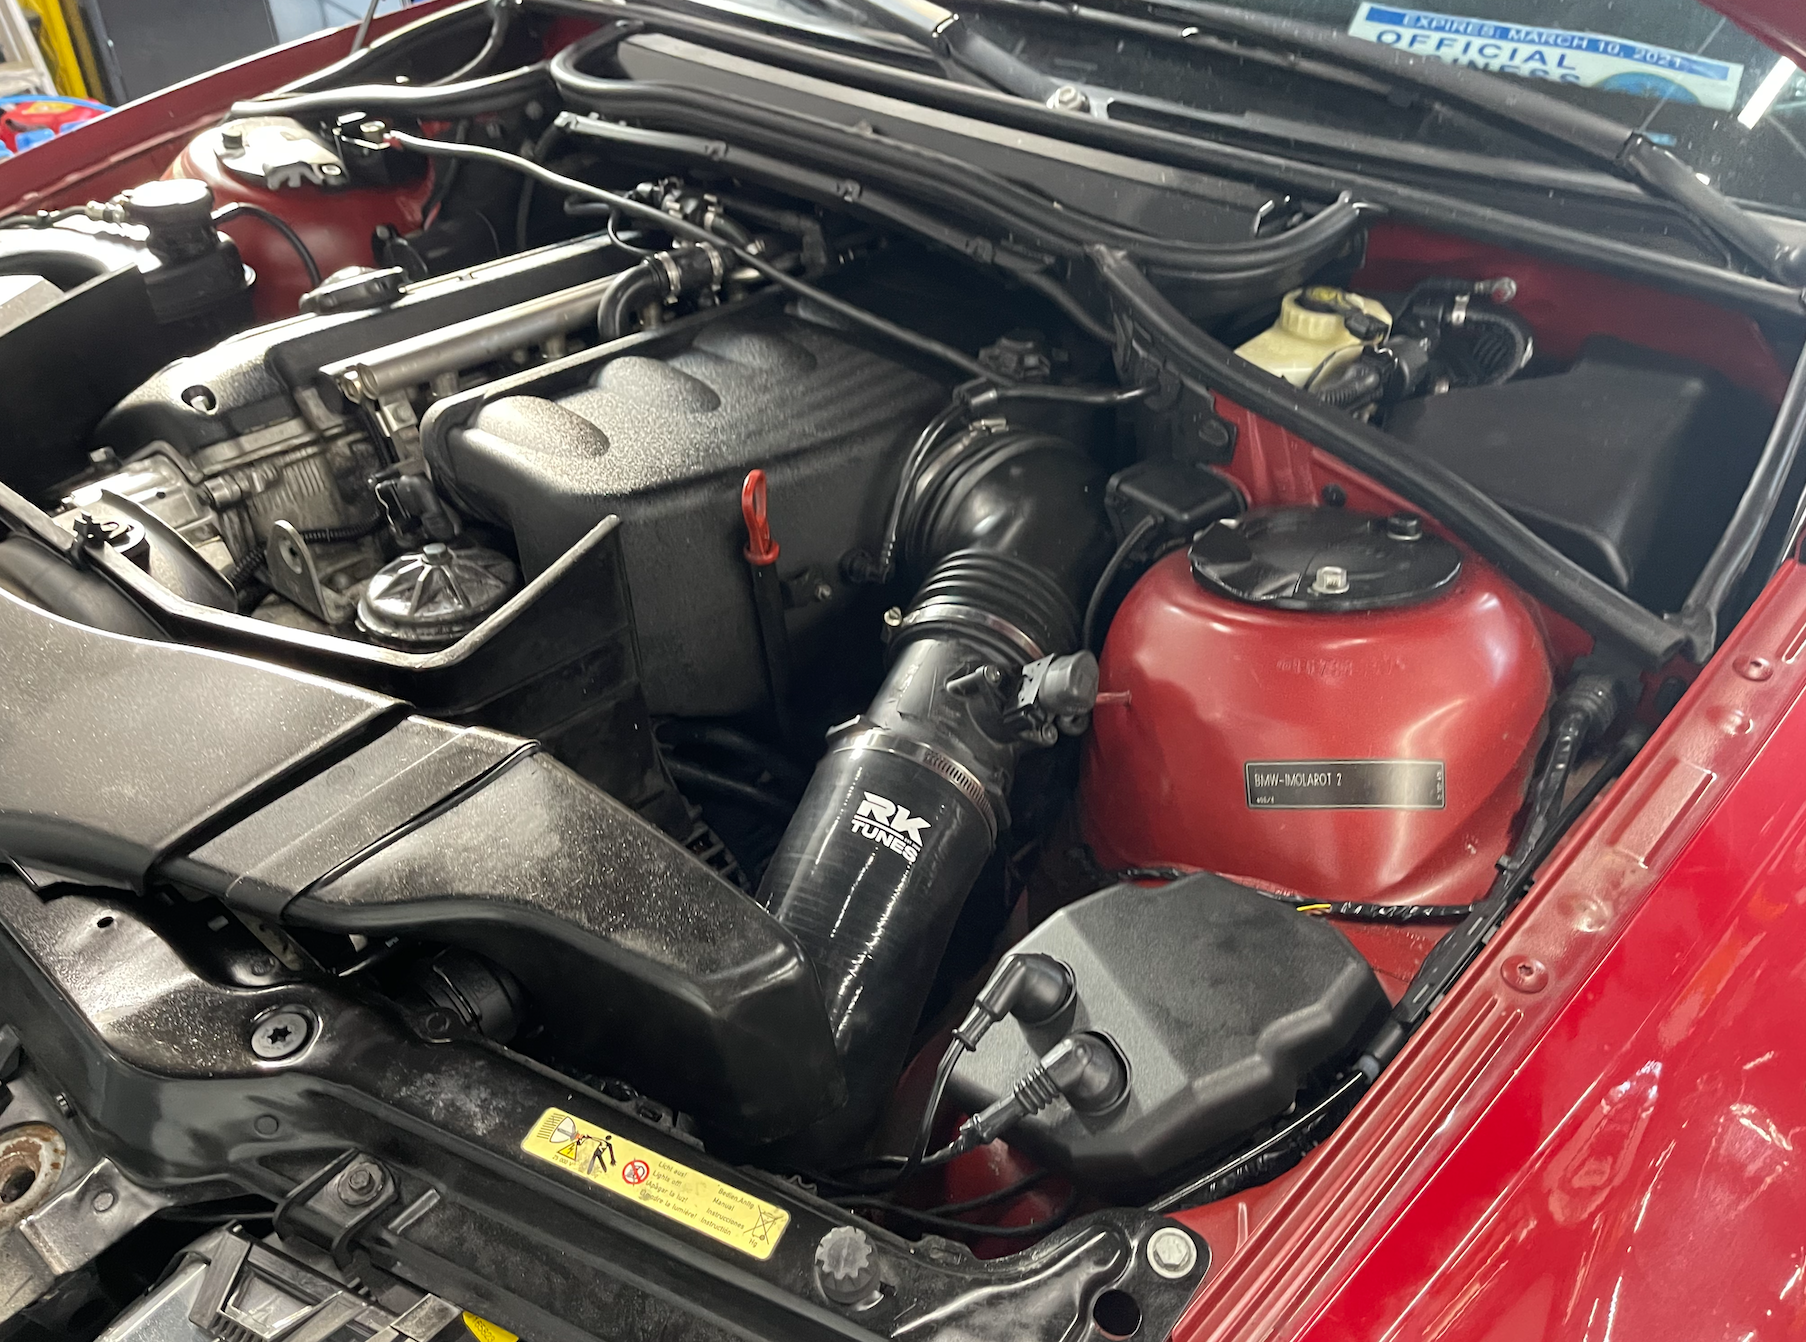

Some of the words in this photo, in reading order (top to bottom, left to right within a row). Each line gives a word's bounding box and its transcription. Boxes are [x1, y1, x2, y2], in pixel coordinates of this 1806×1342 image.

[1376, 29, 1576, 71] OFFICIAL
[1507, 28, 1588, 49] MARCH
[1632, 48, 1682, 69] 2021
[1254, 772, 1332, 788] BMW-IMOLAROT
[856, 791, 932, 847] RK
[851, 819, 918, 863] TUNES
[712, 1197, 735, 1212] Manual
